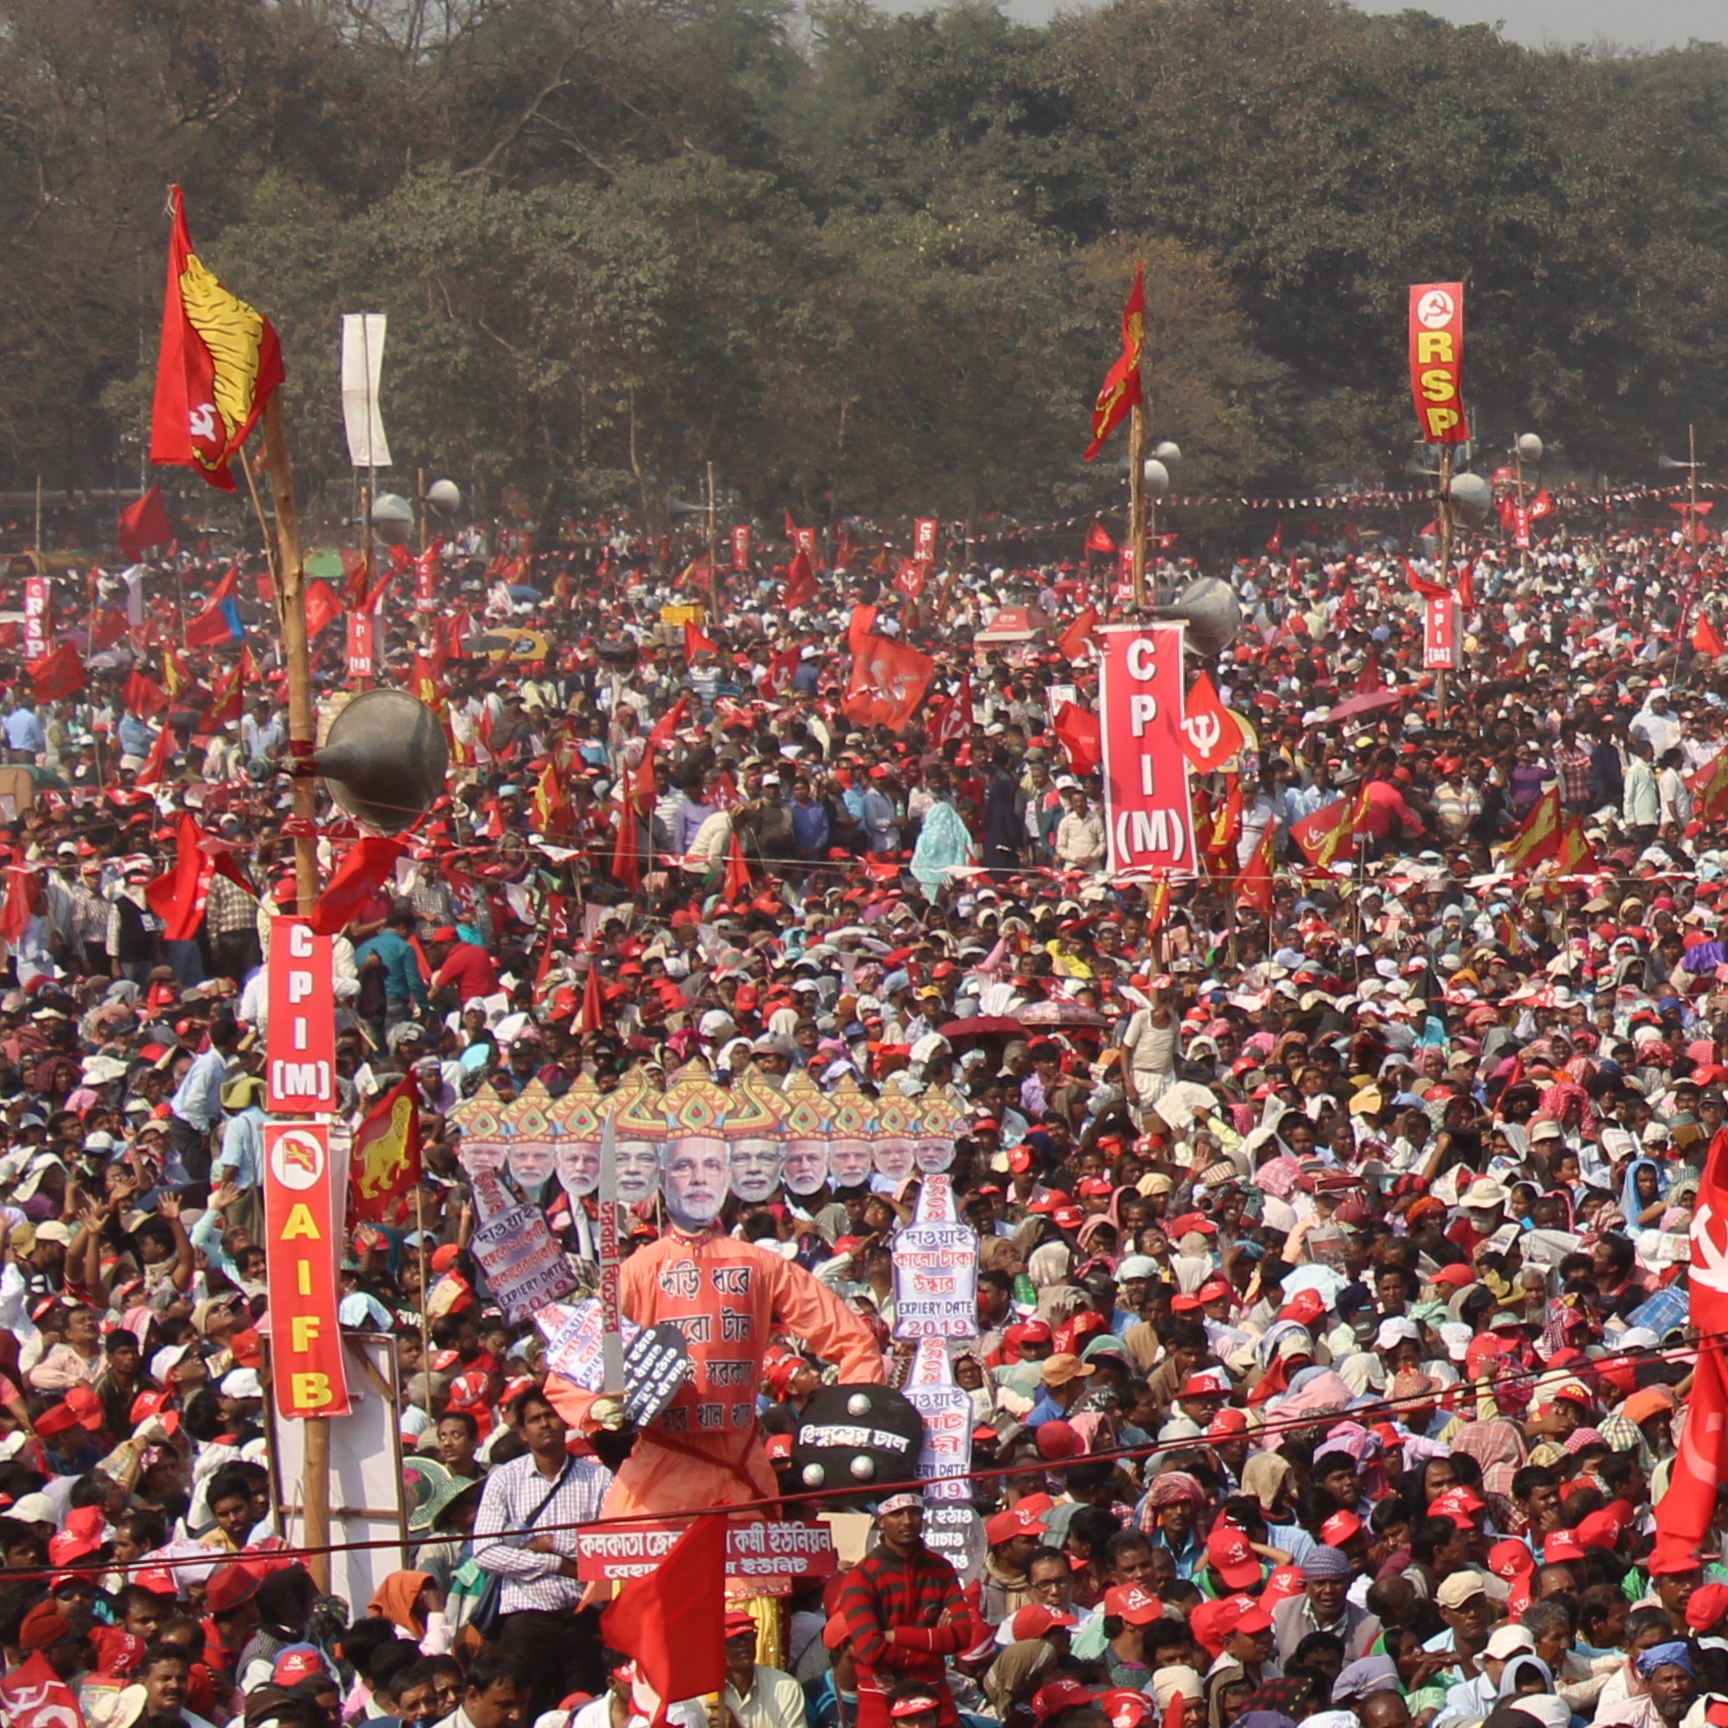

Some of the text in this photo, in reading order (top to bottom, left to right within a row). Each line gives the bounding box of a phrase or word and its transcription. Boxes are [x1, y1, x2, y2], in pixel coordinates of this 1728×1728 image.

[1418, 331, 1460, 437] RSP
[26, 597, 46, 659] RSP
[1116, 638, 1186, 862] CPI(M)
[905, 1226, 970, 1247] দাওয়াই
[541, 1259, 567, 1284] DATE
[712, 1265, 752, 1295] ধরে
[280, 1203, 334, 1409] AIFB
[515, 1279, 570, 1319] 2019
[899, 1300, 973, 1316] EXPIERY DATE
[908, 1319, 968, 1337] 2019
[939, 1463, 967, 1477] DATE
[579, 1530, 645, 1560] কলকাতা
